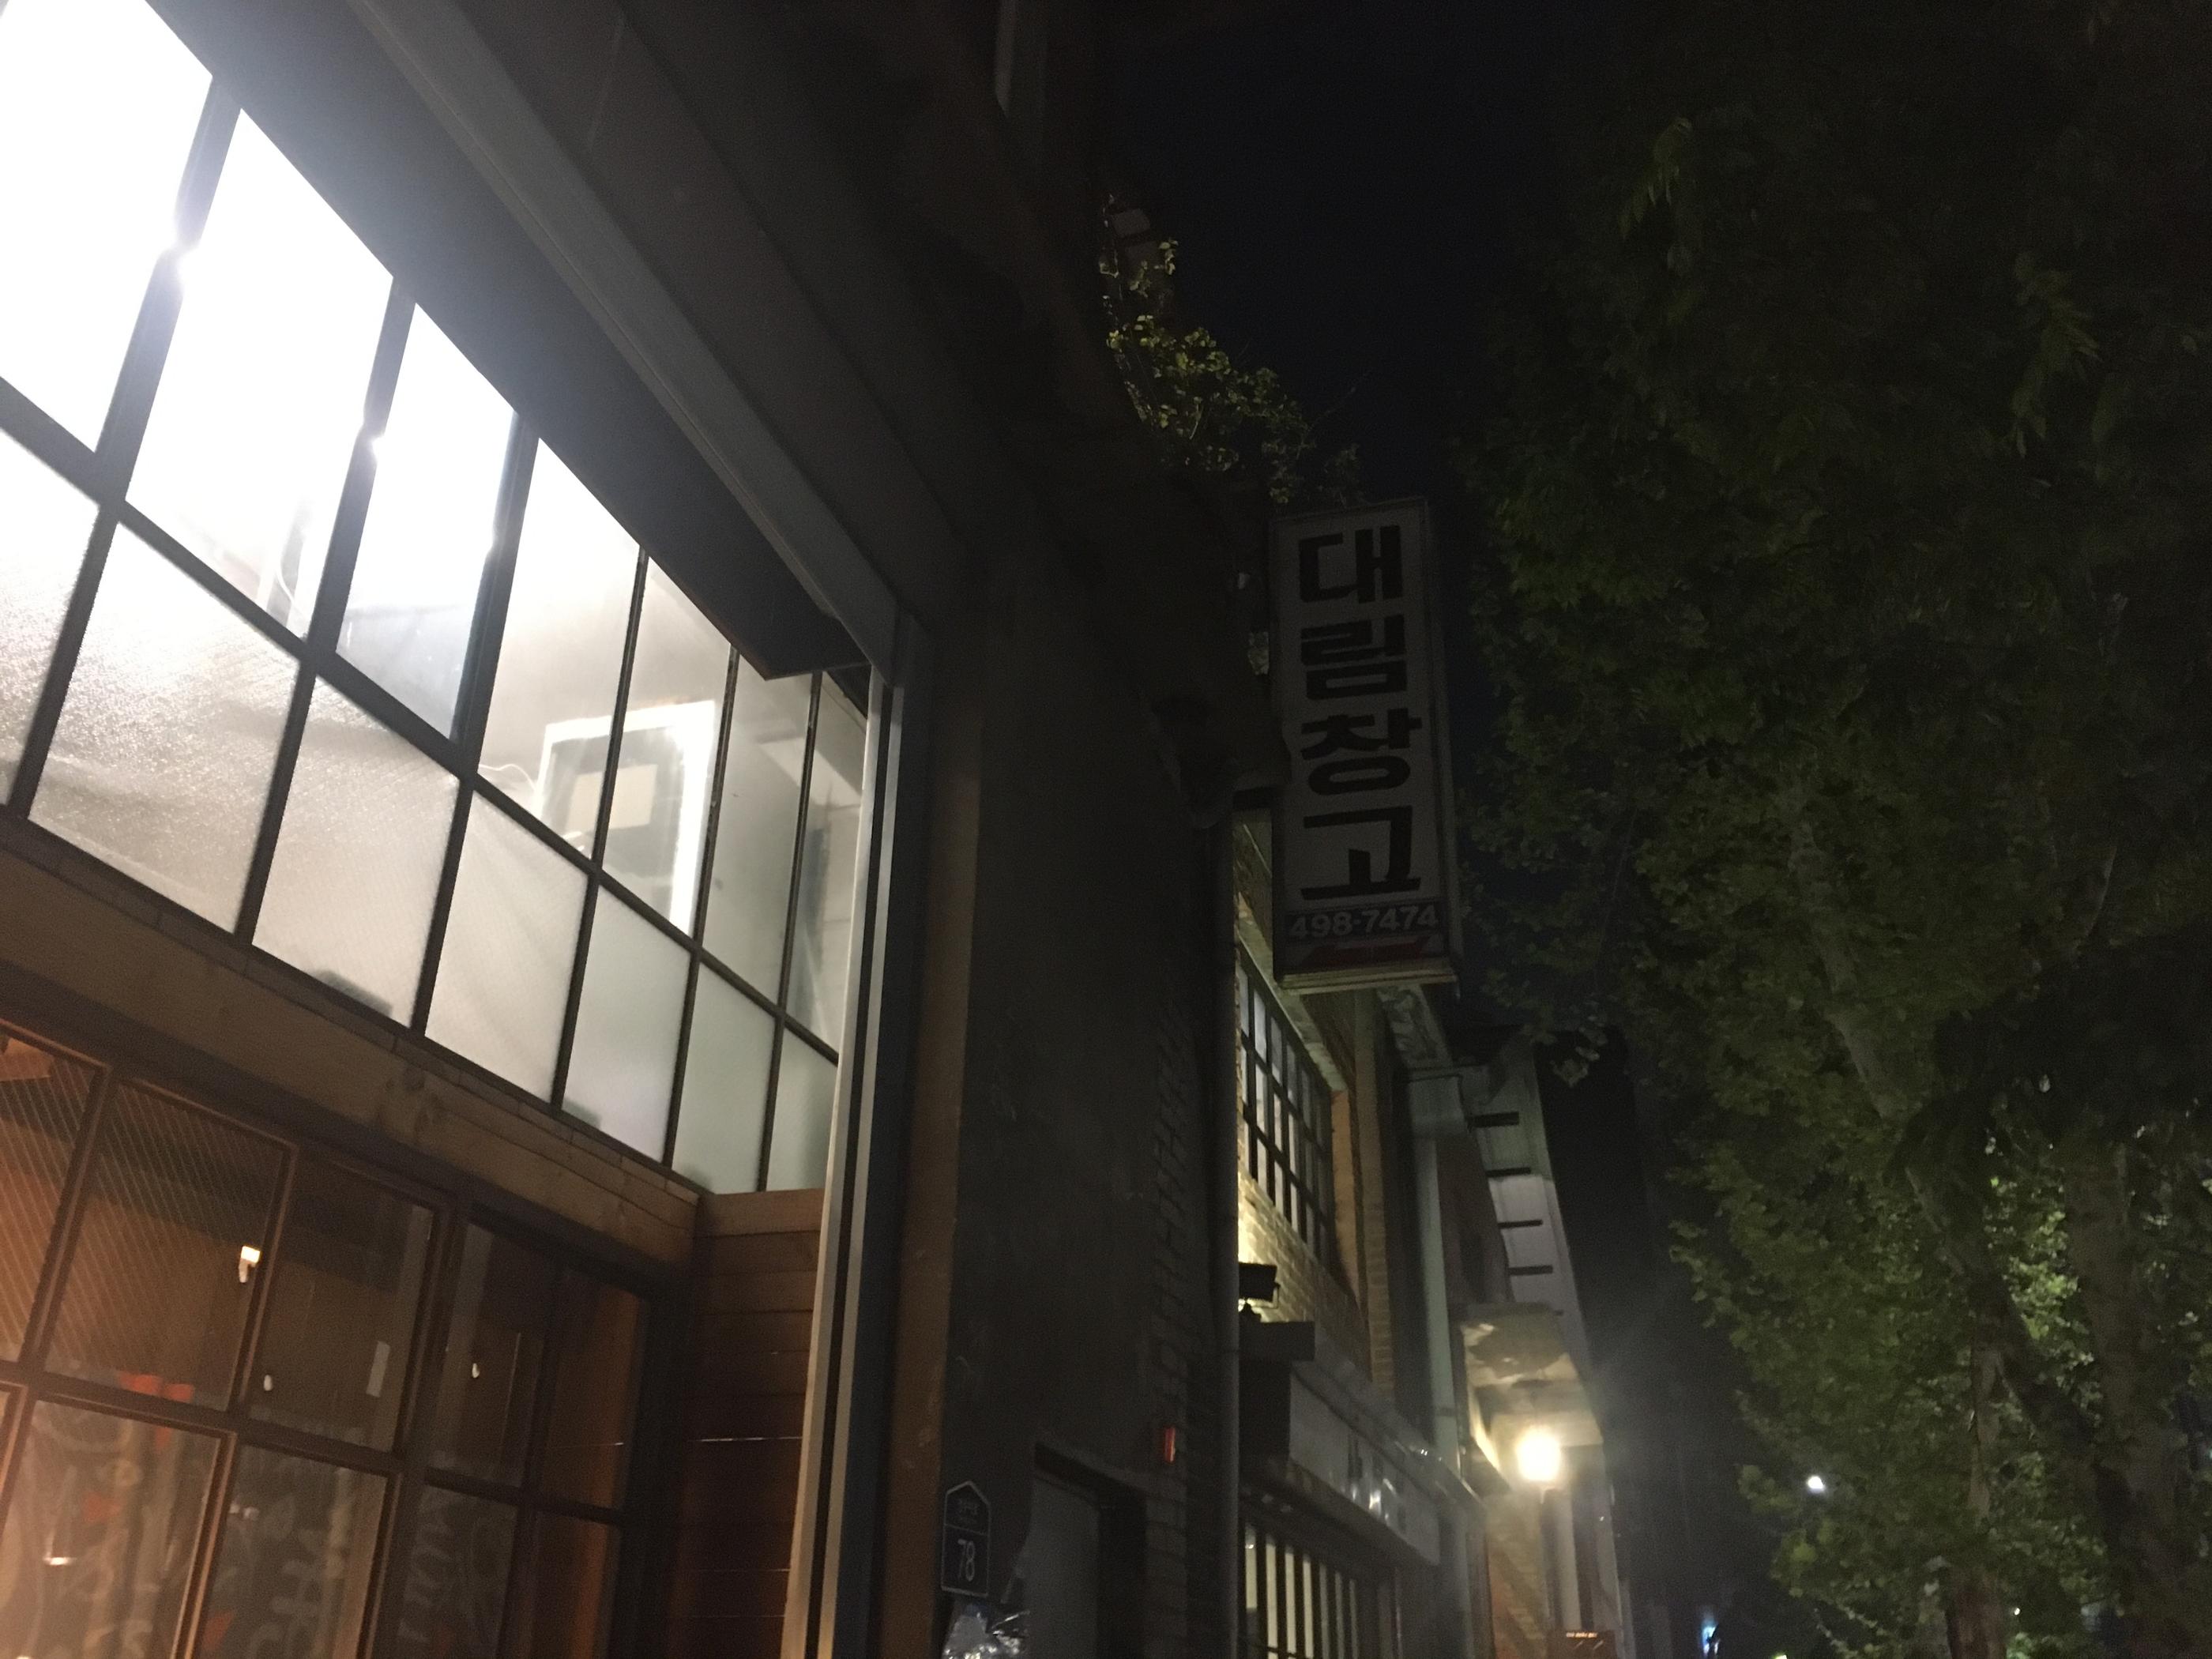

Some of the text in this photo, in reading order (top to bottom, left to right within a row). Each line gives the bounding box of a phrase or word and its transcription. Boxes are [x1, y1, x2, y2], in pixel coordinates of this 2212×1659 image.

[1299, 525, 1422, 901] 대림창고
[1289, 905, 1439, 939] 498-7474
[957, 1539, 976, 1582] 78
